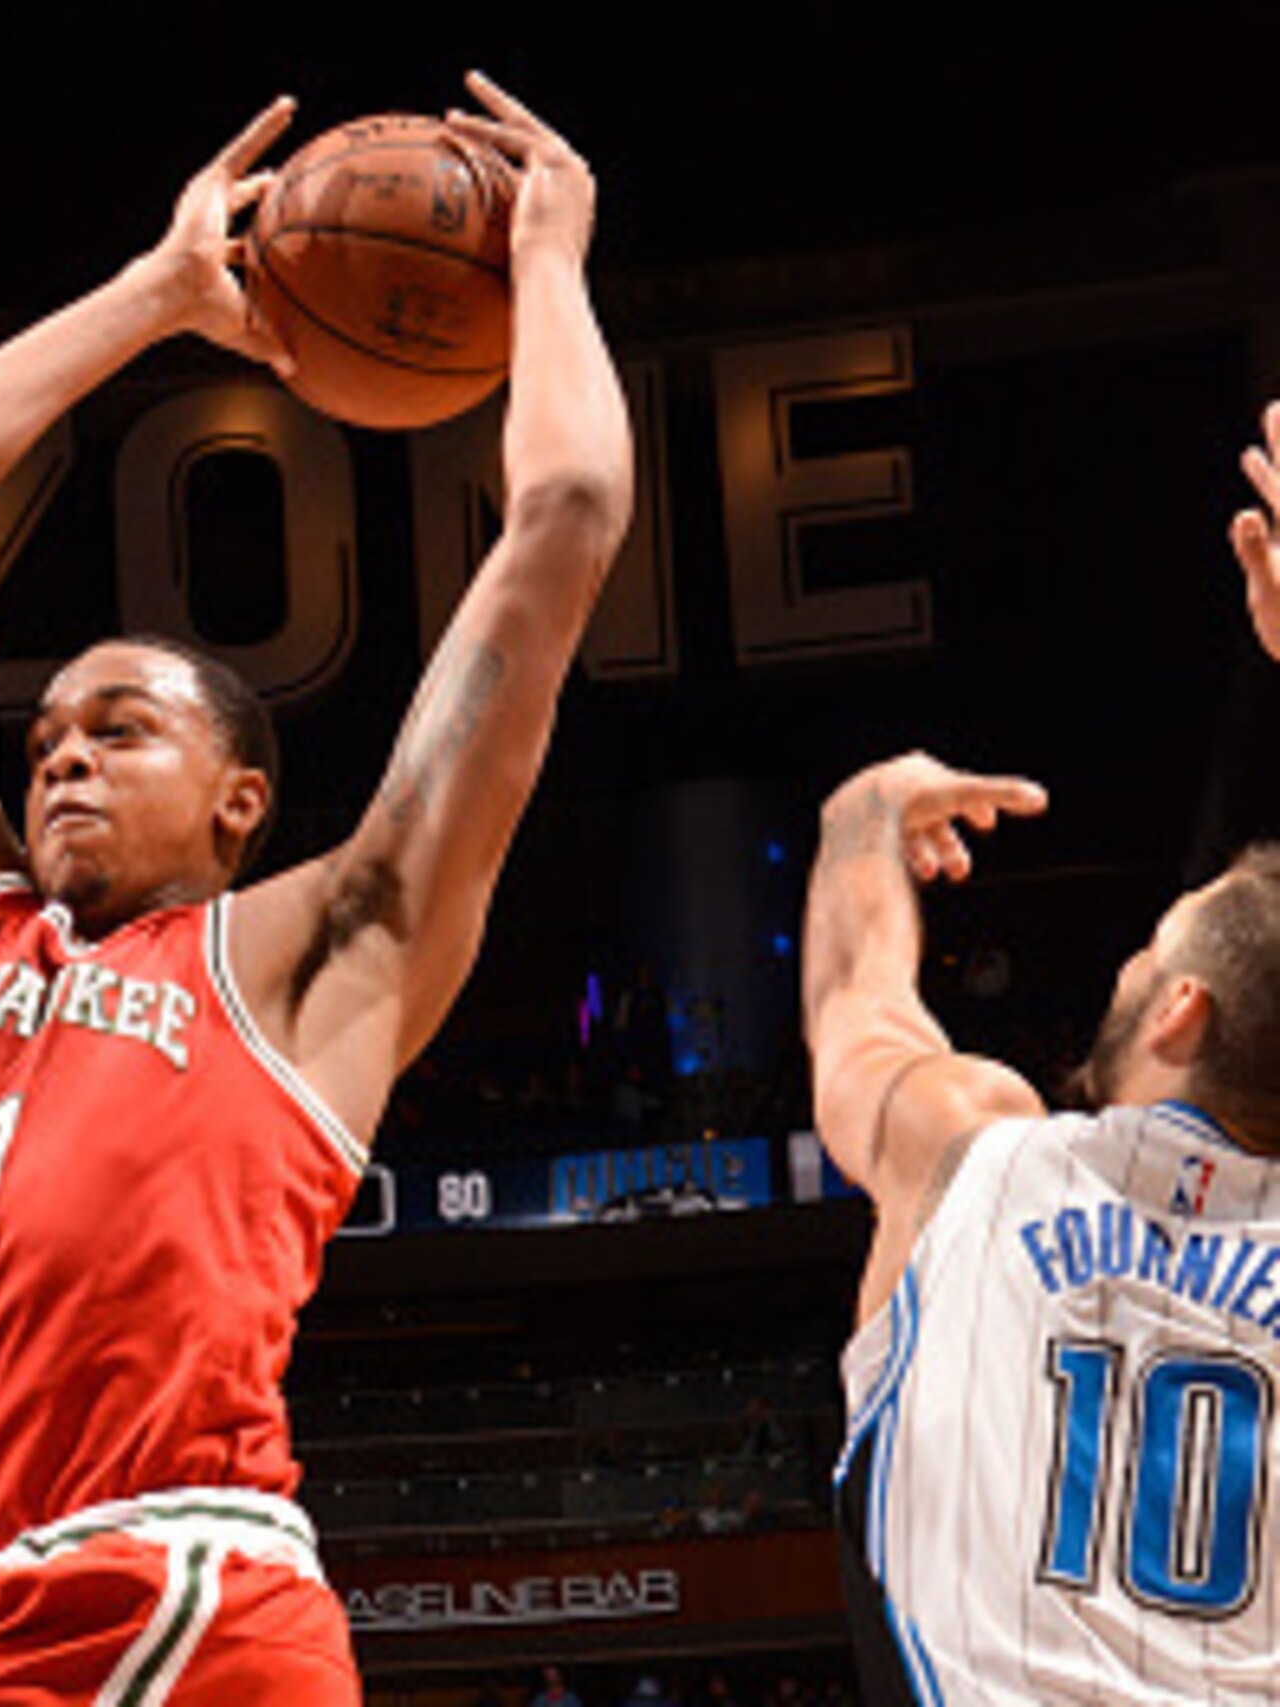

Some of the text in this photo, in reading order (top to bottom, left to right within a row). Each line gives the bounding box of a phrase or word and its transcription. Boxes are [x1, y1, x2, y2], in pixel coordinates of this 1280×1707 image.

[437, 1173, 490, 1220] 80
[1035, 1337, 1275, 1623] 10
[347, 1568, 682, 1623] ASELINE BAR
